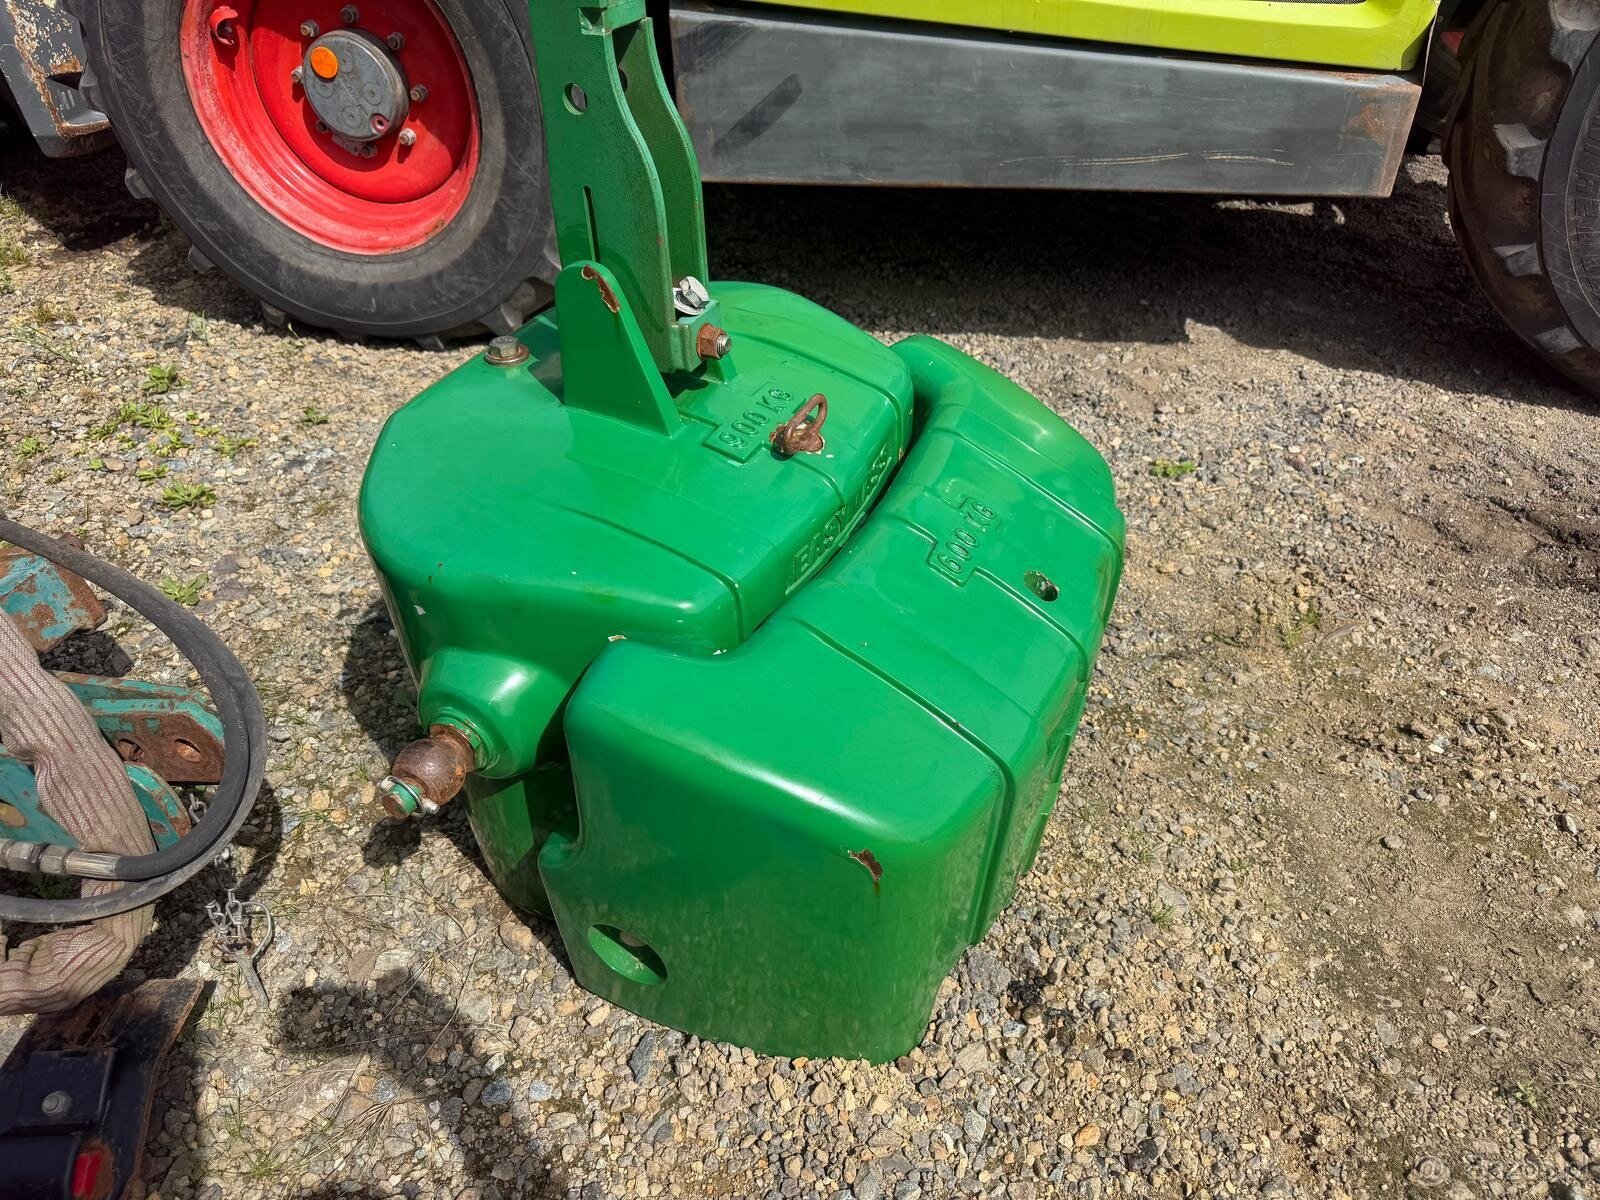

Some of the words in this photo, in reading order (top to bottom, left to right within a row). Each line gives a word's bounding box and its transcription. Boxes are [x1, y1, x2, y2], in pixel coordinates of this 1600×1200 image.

[719, 410, 768, 448] 900
[756, 388, 792, 414] KG
[937, 528, 979, 575] 600
[964, 499, 997, 531] KG
